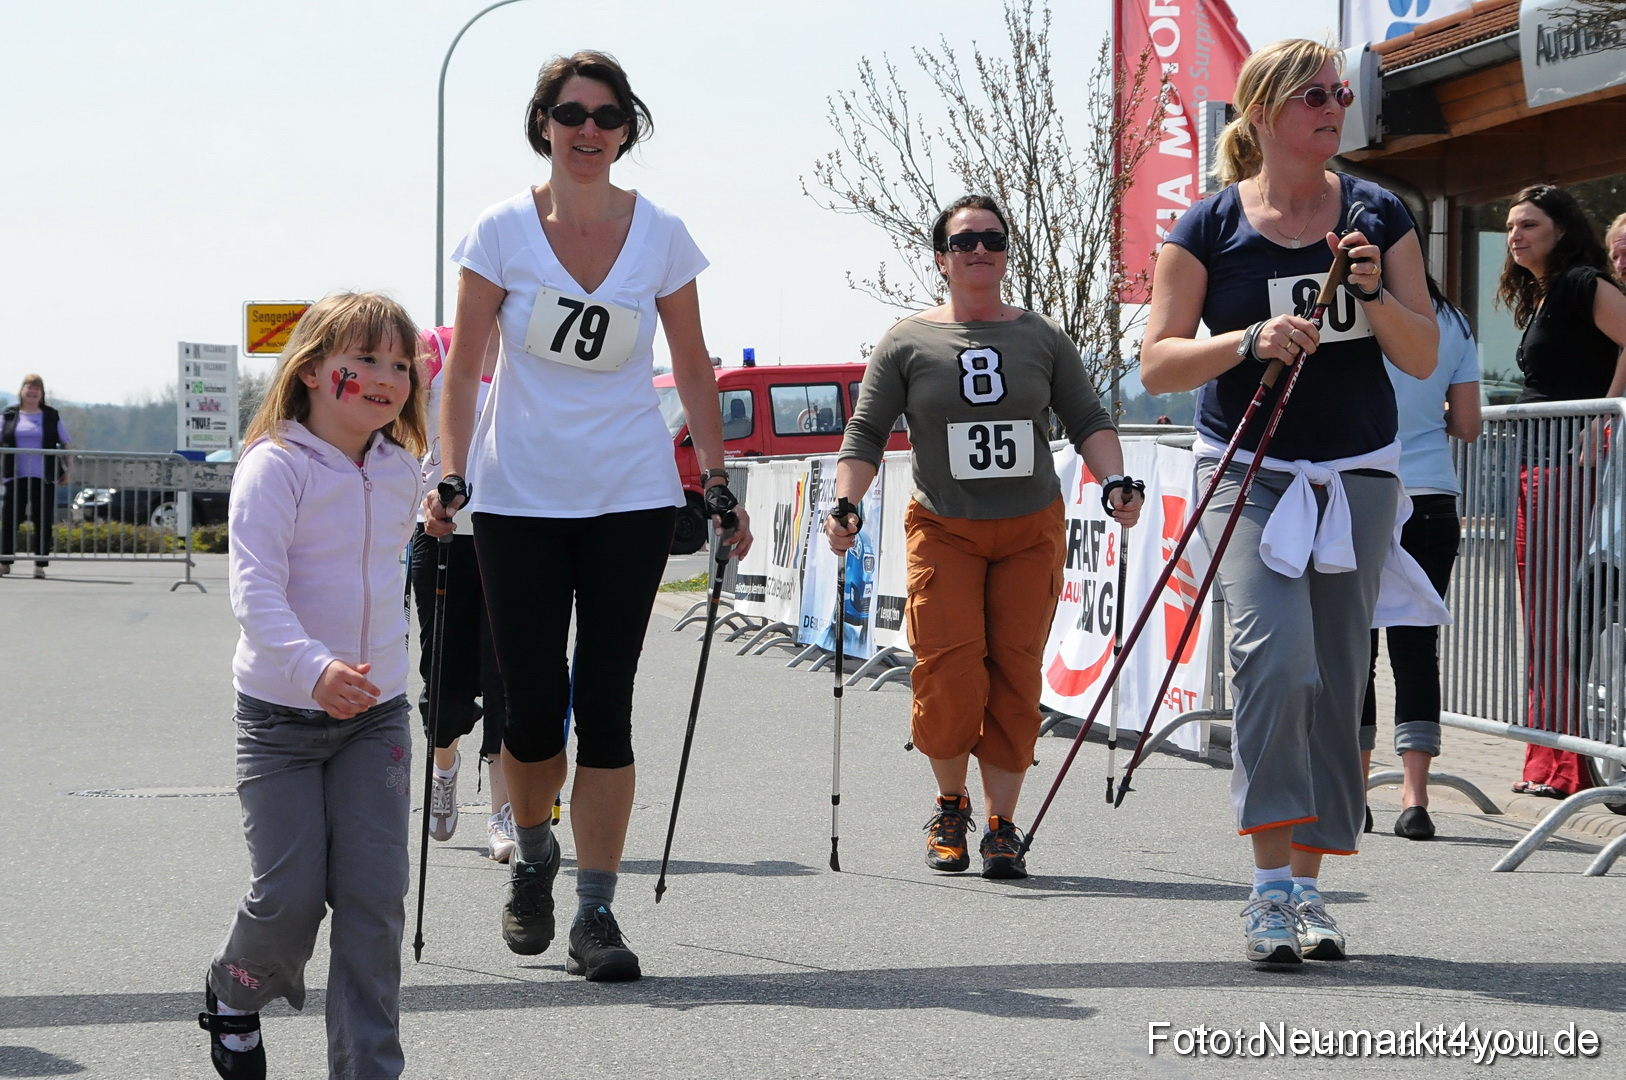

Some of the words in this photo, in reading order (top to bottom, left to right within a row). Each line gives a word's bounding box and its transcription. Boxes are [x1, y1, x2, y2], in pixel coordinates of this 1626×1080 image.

[252, 309, 303, 325] Sengenth
[549, 296, 610, 361] 79
[957, 346, 1008, 407] 8
[1282, 351, 1308, 405] ORDIC
[968, 424, 1017, 471] 35
[1211, 417, 1247, 479] NORDIC
[1106, 532, 1115, 567] &
